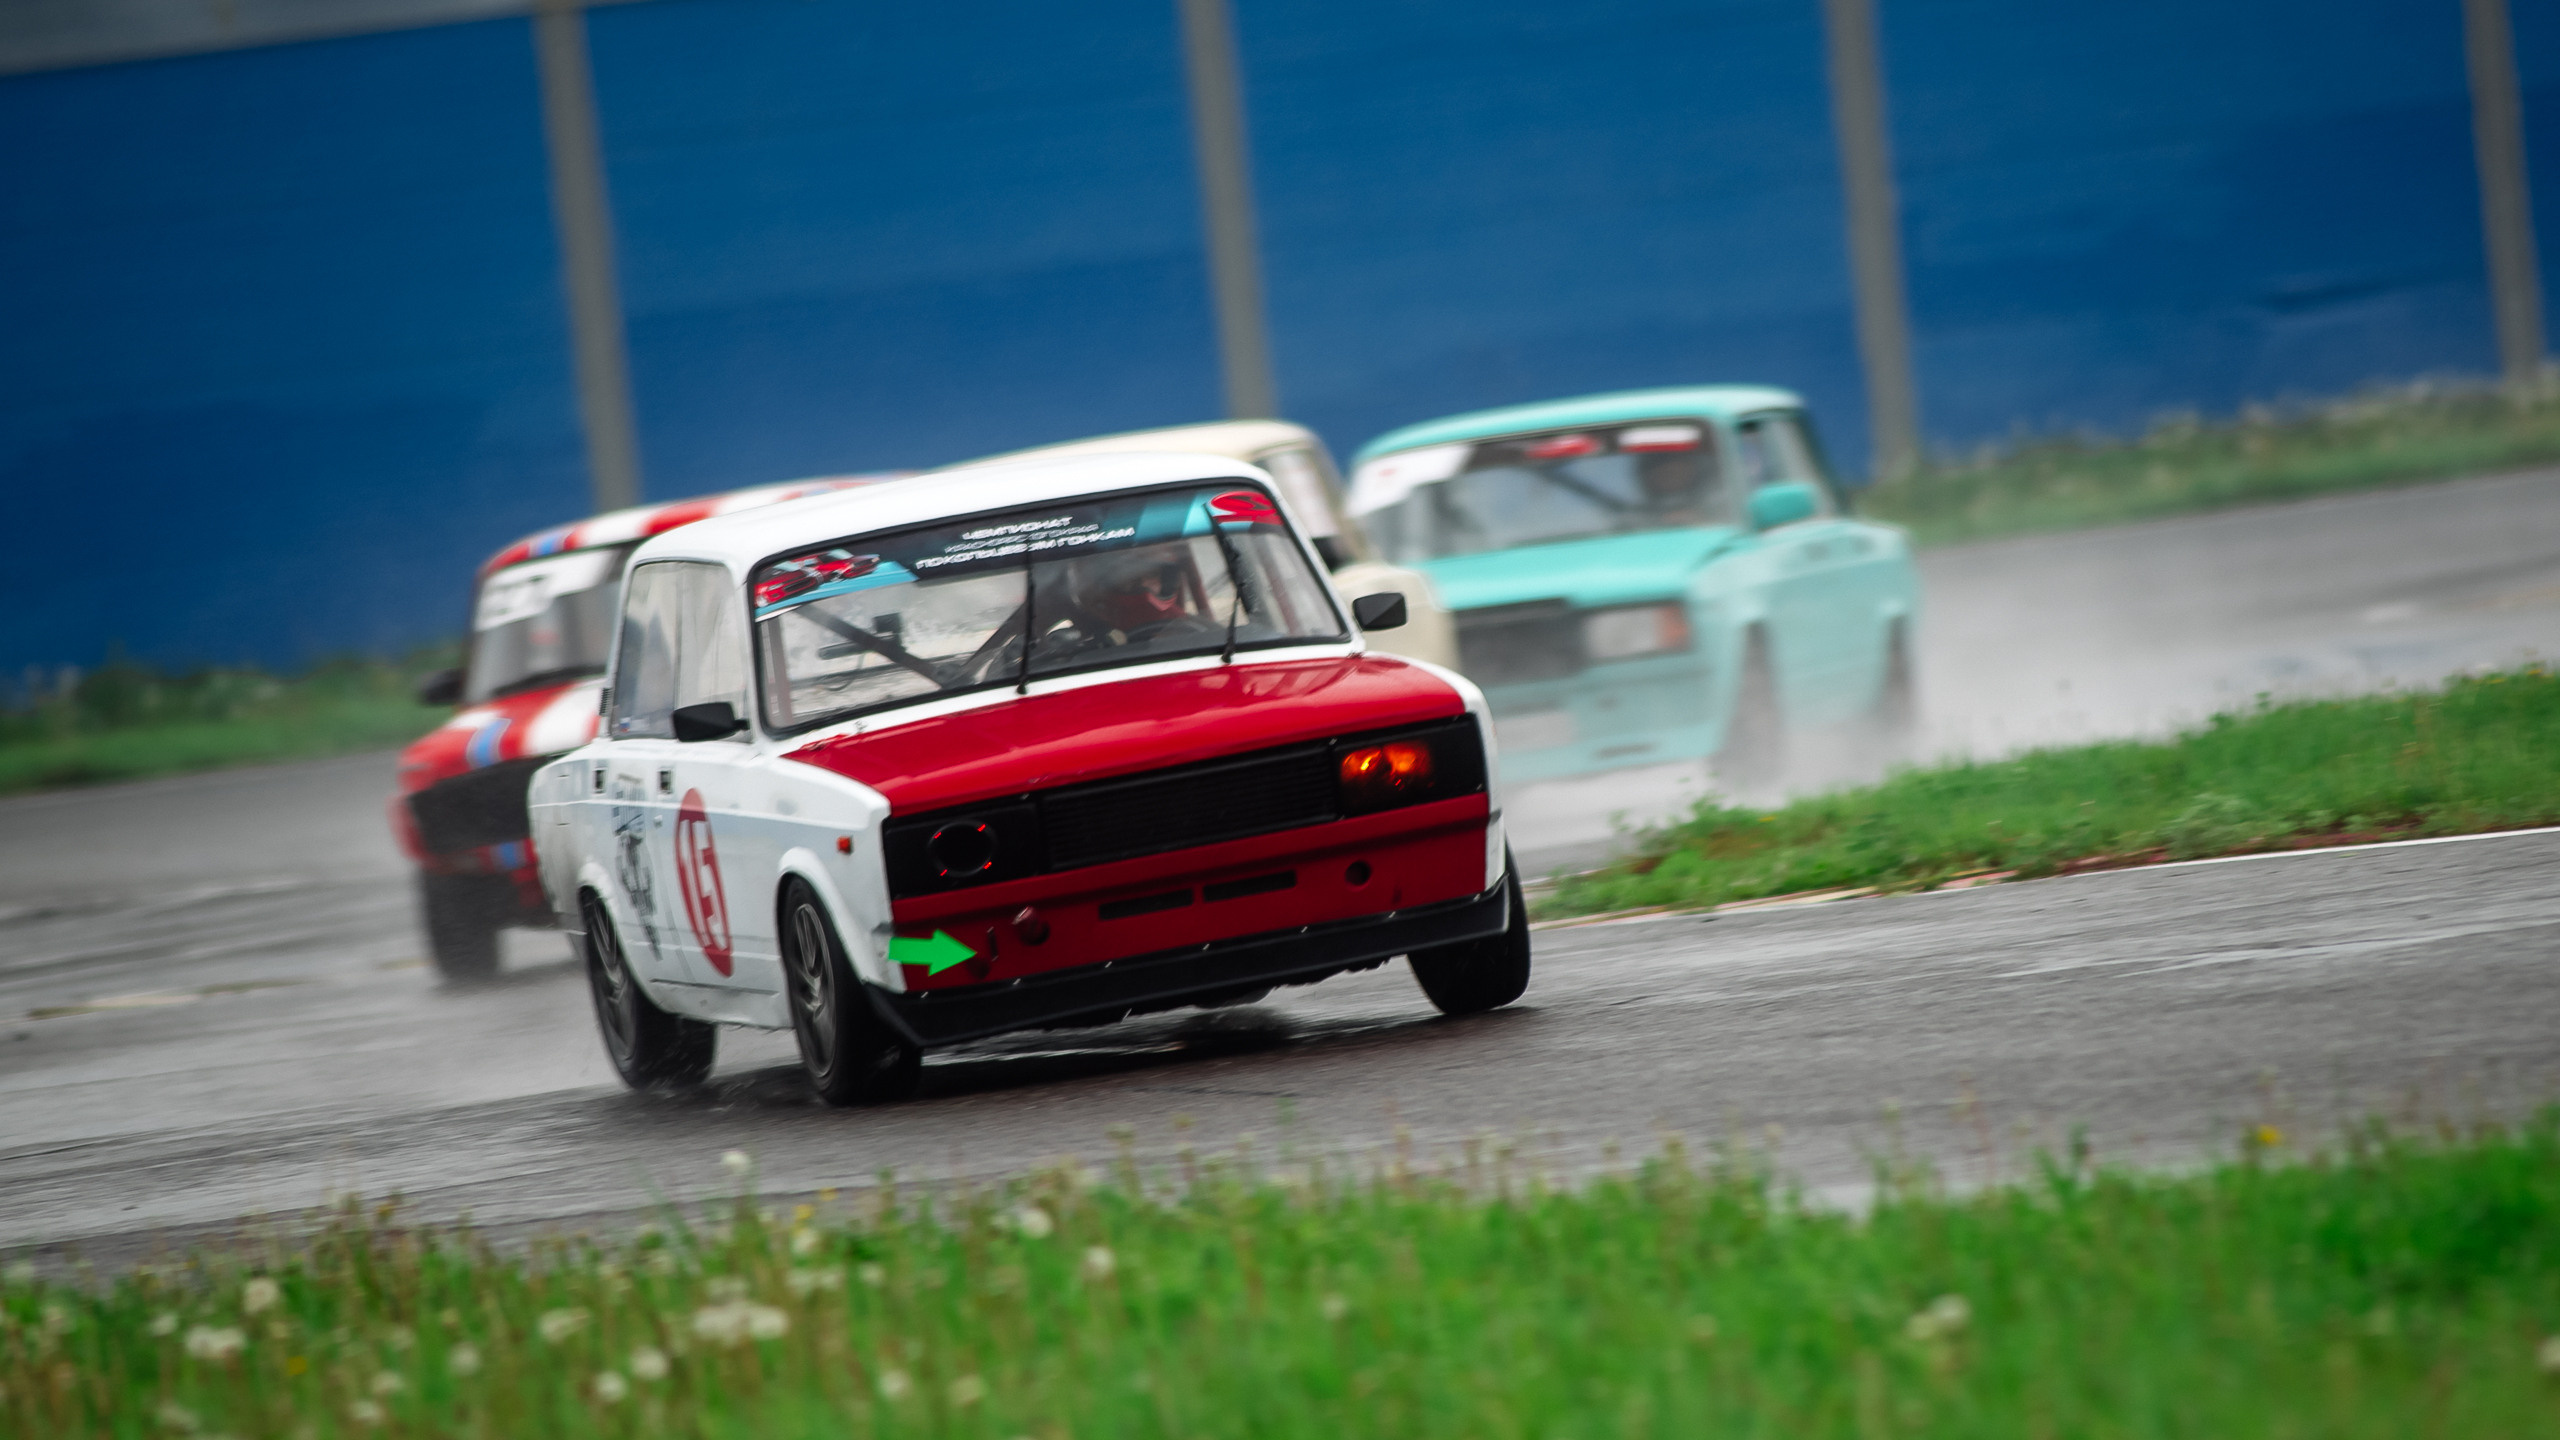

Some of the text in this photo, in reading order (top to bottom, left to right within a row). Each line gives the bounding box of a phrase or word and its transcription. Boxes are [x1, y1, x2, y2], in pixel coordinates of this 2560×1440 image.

[962, 516, 1073, 540] ЧЕМПИОНАТ
[1057, 526, 1136, 548] ГОНКАМ
[678, 818, 728, 951] 15
